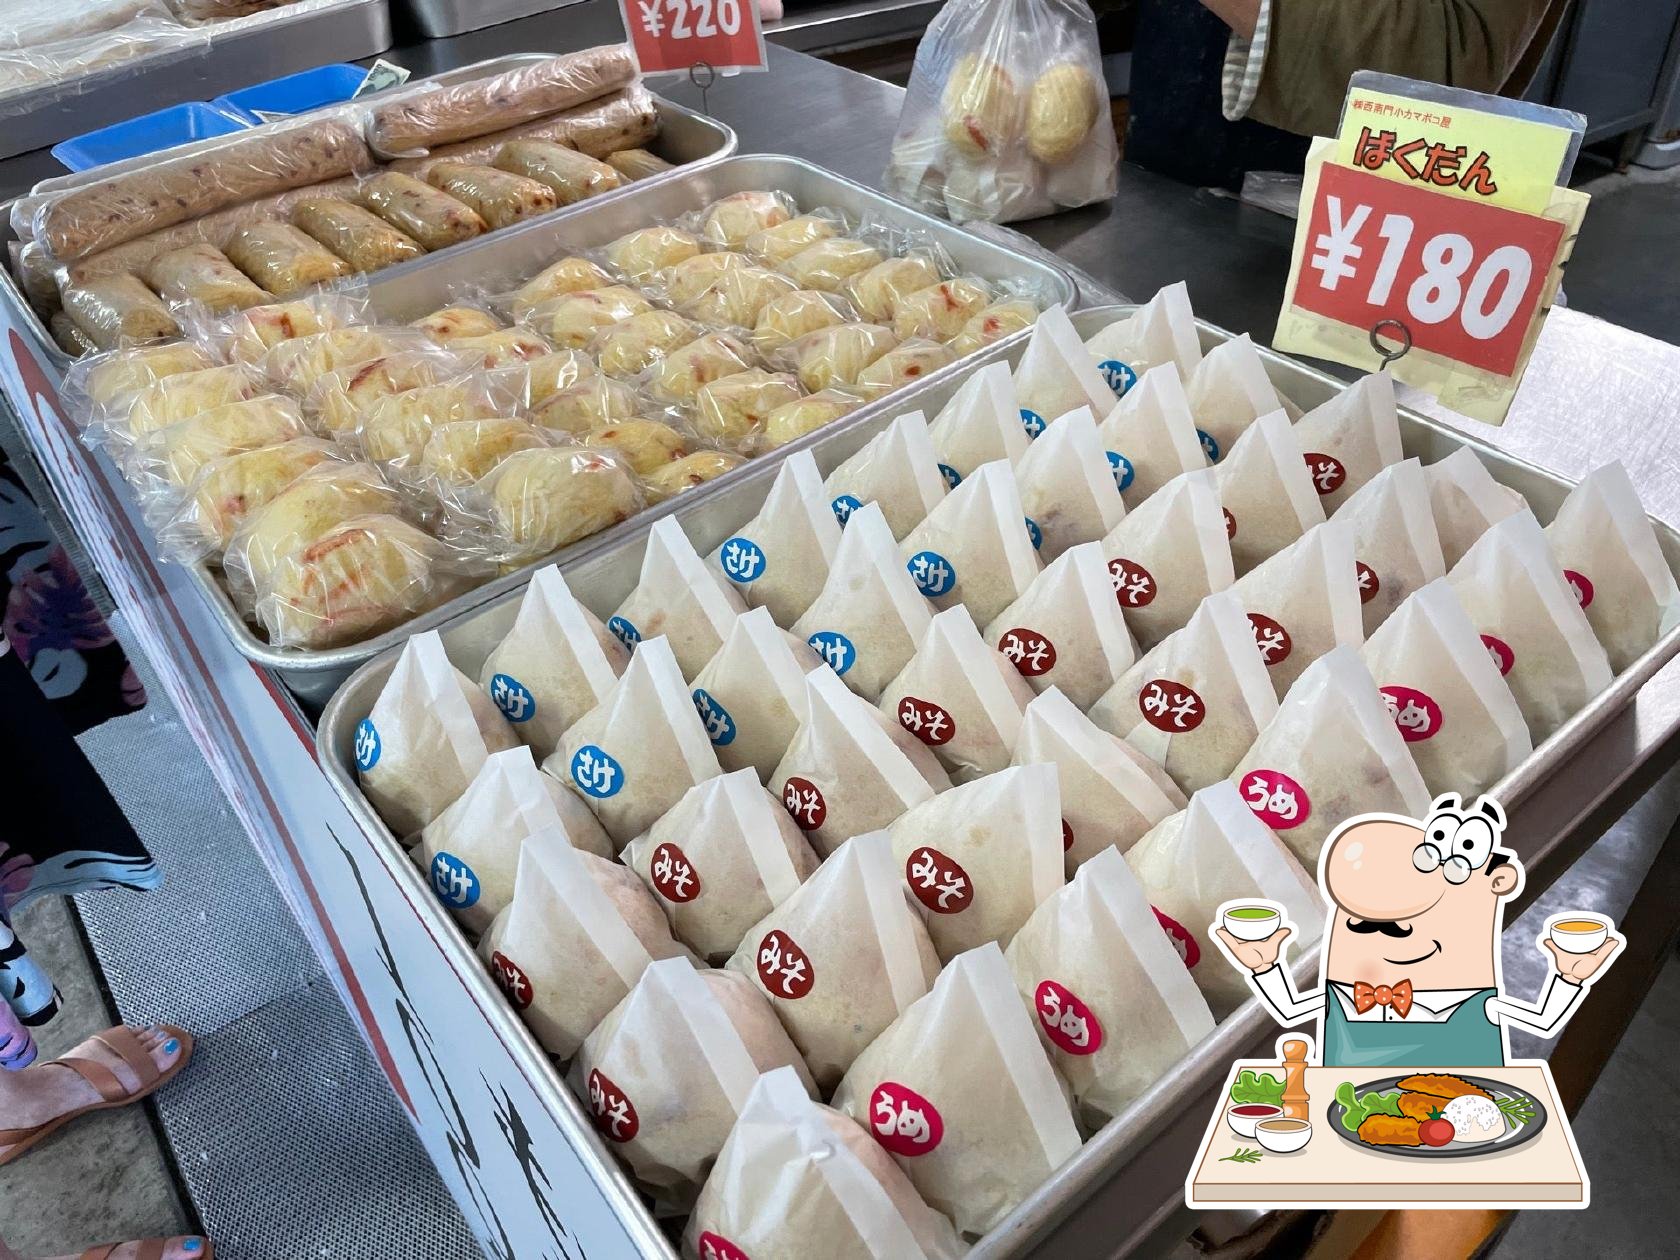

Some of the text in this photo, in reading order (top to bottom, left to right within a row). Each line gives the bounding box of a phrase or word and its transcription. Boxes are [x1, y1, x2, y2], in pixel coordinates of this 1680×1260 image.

[638, 0, 742, 39] ¥220
[1353, 126, 1498, 196] ばくだん
[1311, 194, 1533, 340] ¥180
[725, 542, 760, 577] さけ
[912, 555, 949, 592] さけ
[1003, 633, 1050, 671] みそ
[495, 677, 529, 719] さけ
[901, 699, 950, 741] みそ
[1144, 683, 1198, 728] みそ
[355, 724, 377, 767] さけ
[577, 750, 616, 794] さけ
[785, 782, 823, 825] みそ
[1247, 776, 1299, 820] うめ
[436, 857, 473, 904] さけ
[654, 847, 694, 898] みそ
[911, 850, 967, 909] みそ
[760, 934, 807, 995] みそ
[1042, 986, 1090, 1047] うめ
[590, 1073, 632, 1138] みそ
[874, 1090, 931, 1144] うめ
